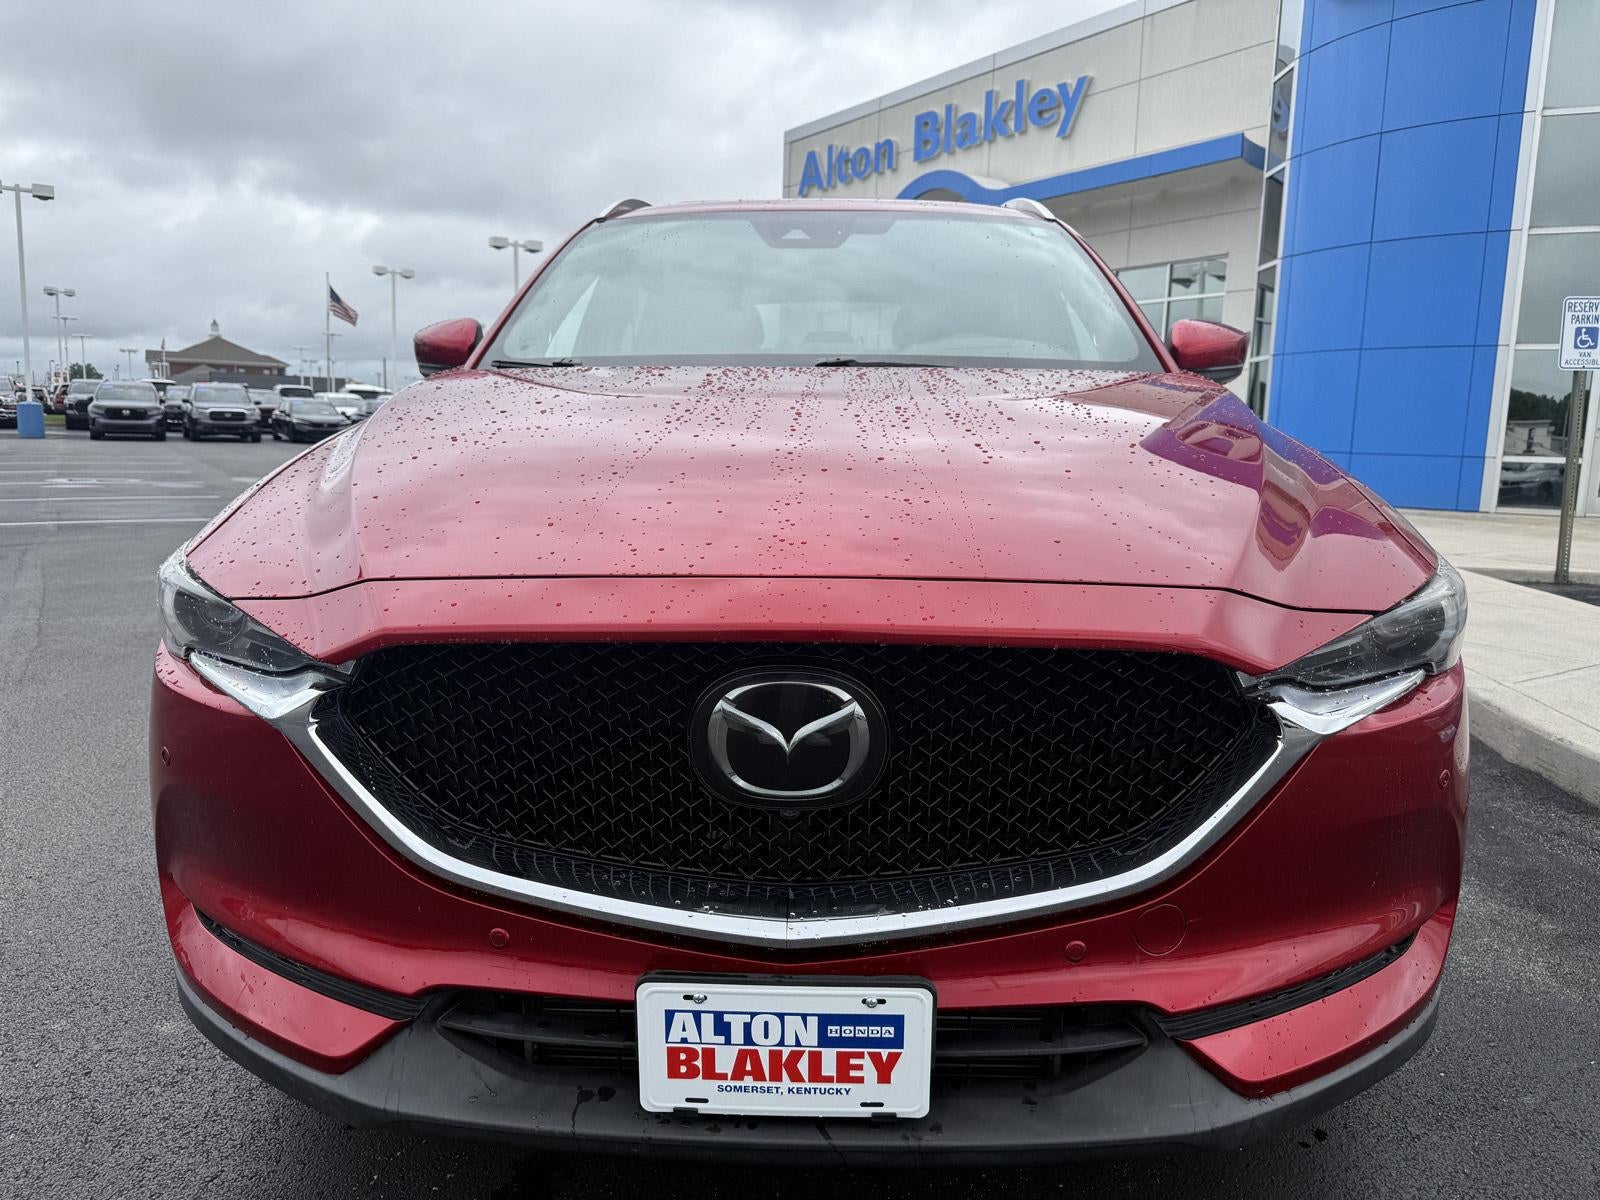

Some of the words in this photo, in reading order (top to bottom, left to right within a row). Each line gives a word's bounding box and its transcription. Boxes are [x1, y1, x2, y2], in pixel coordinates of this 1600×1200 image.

[799, 138, 897, 197] Alton
[913, 75, 1093, 162] Blakley
[1571, 315, 1600, 325] PARKIN
[667, 1012, 819, 1047] ALTON
[827, 1026, 894, 1037] HONDA
[666, 1046, 903, 1085] BLAKLEY
[717, 1084, 784, 1096] SOMERSET,
[787, 1086, 852, 1096] KENTUCKY
